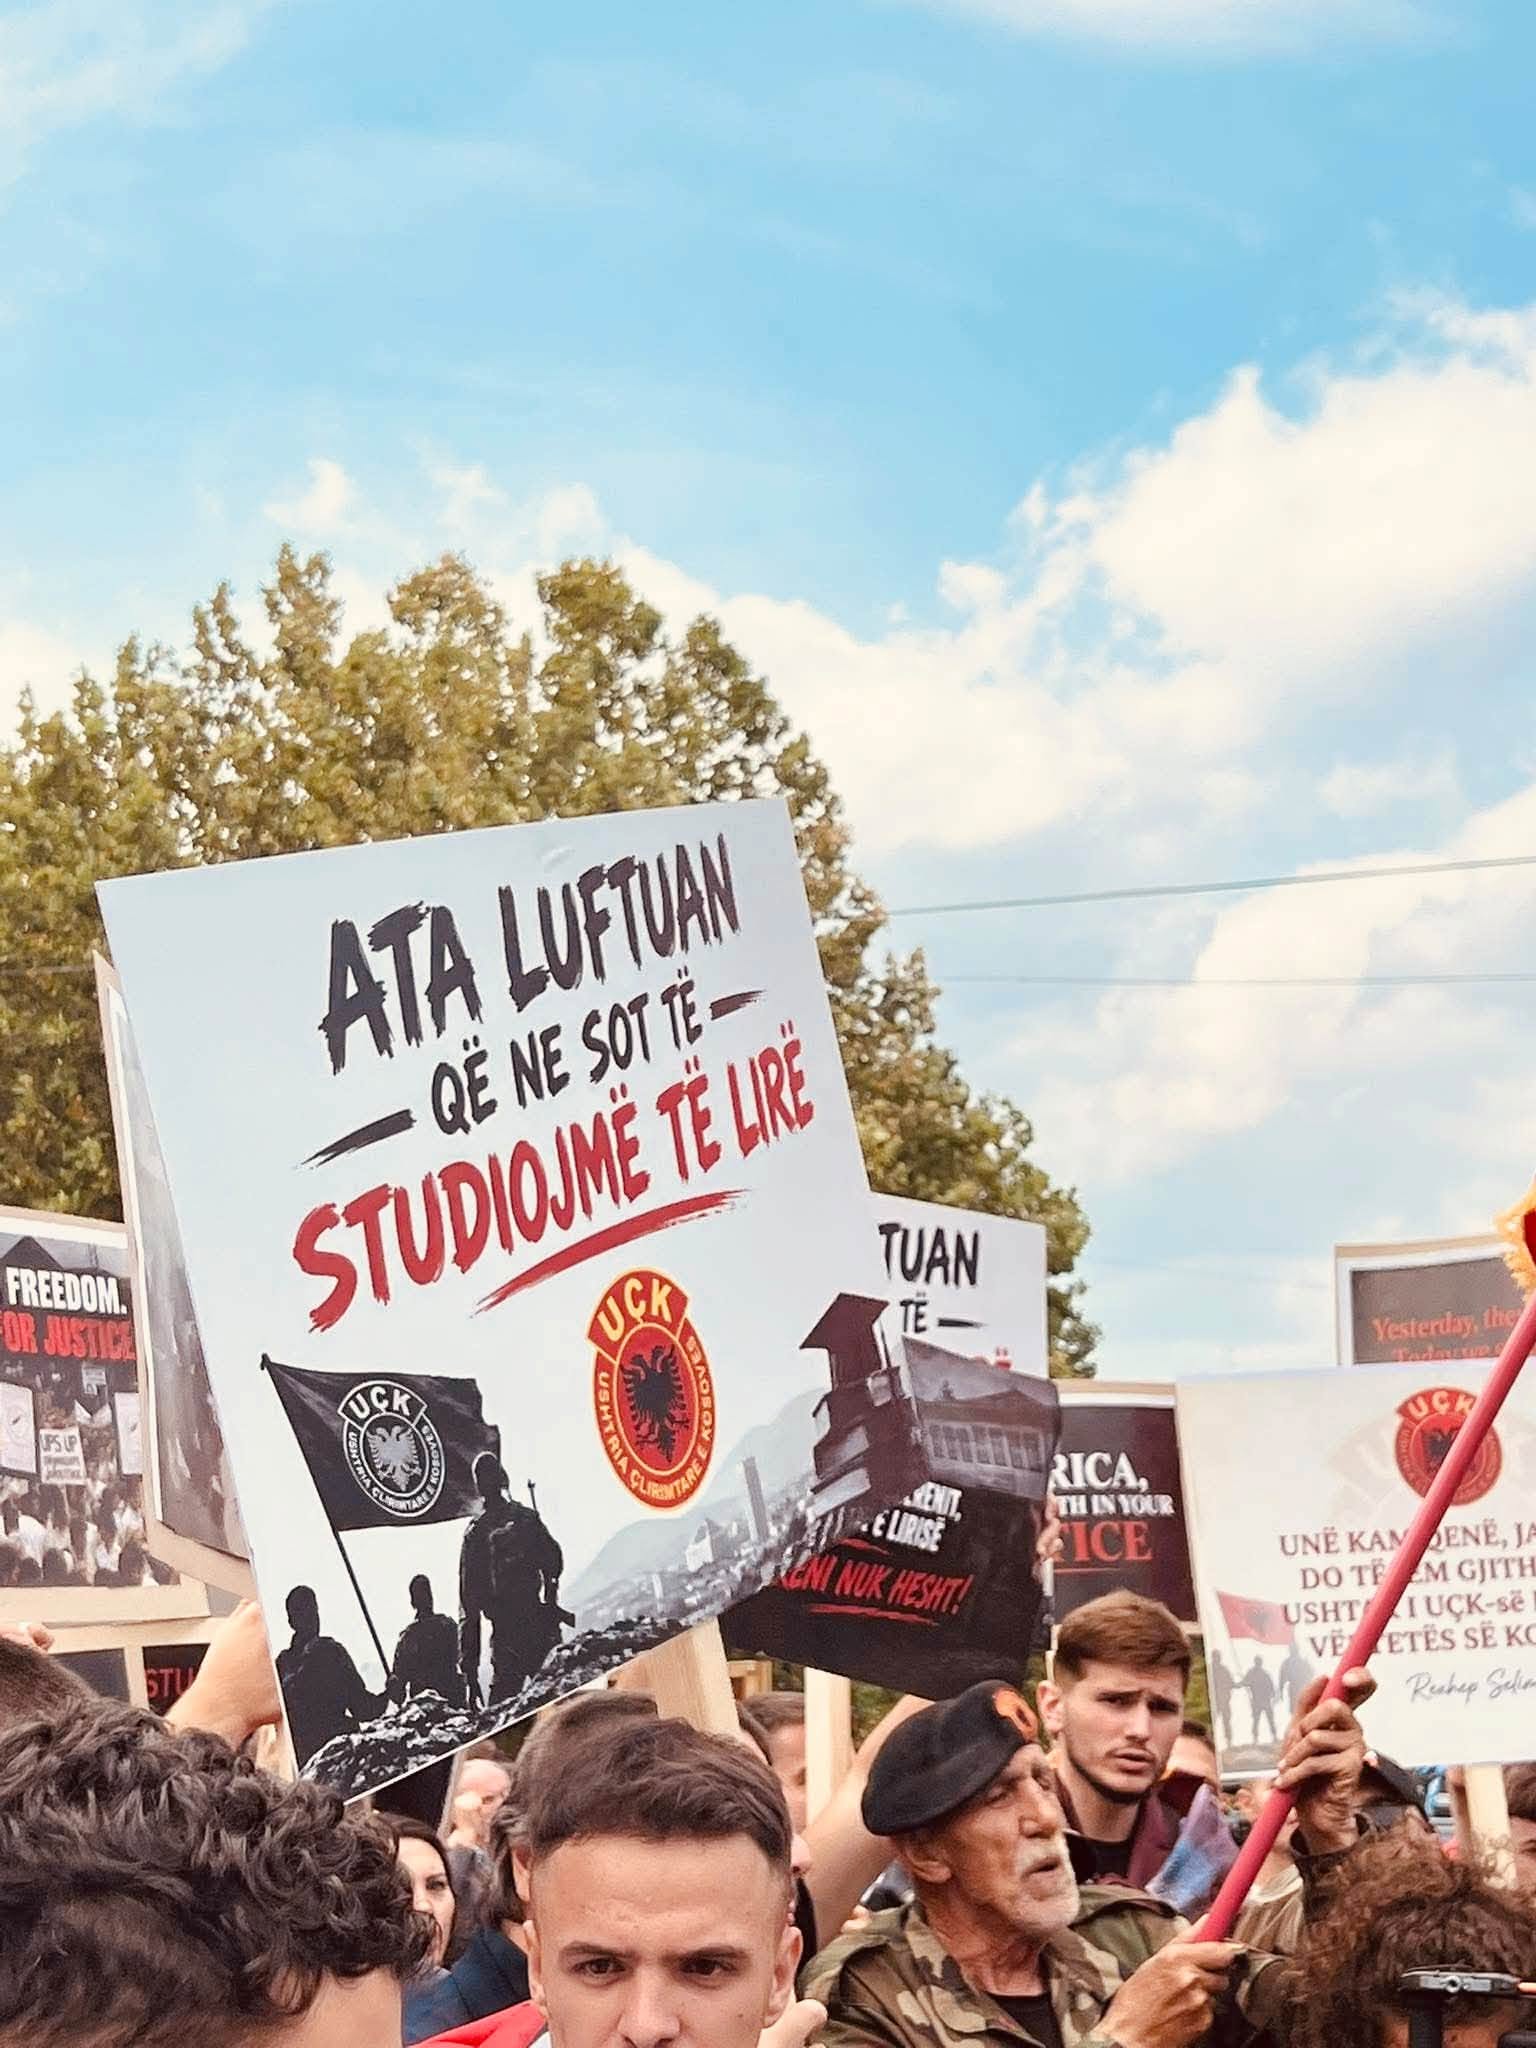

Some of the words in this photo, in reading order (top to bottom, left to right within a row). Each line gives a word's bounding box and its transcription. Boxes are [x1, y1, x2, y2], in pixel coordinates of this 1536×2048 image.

[319, 901, 483, 1075] ATA
[499, 833, 741, 1012] LUFTUAN
[431, 1036, 498, 1135] QË
[512, 1022, 570, 1109] NE
[581, 992, 652, 1084] SOT
[661, 967, 705, 1049] TË
[292, 1083, 652, 1334] STUDIOJMË
[656, 1056, 723, 1184] TË
[727, 1020, 815, 1160] LIRË
[878, 1222, 980, 1289] TUAN
[6, 1265, 128, 1315] FREEDOM.
[598, 1276, 673, 1343] UÇK
[900, 1291, 929, 1334] TË
[1372, 1311, 1479, 1344] Yesterday,
[44, 1315, 136, 1361] JUSTICE
[1050, 1451, 1149, 1492] RICA,
[1118, 1494, 1175, 1516] YOUR
[1279, 1526, 1340, 1556] UNË
[835, 1560, 895, 1600] NUK
[1300, 1565, 1343, 1590] DO
[1457, 1556, 1536, 1584] GJITH
[1464, 1620, 1498, 1650] SË
[1505, 1622, 1536, 1647] KO
[145, 1666, 195, 1699] STU
